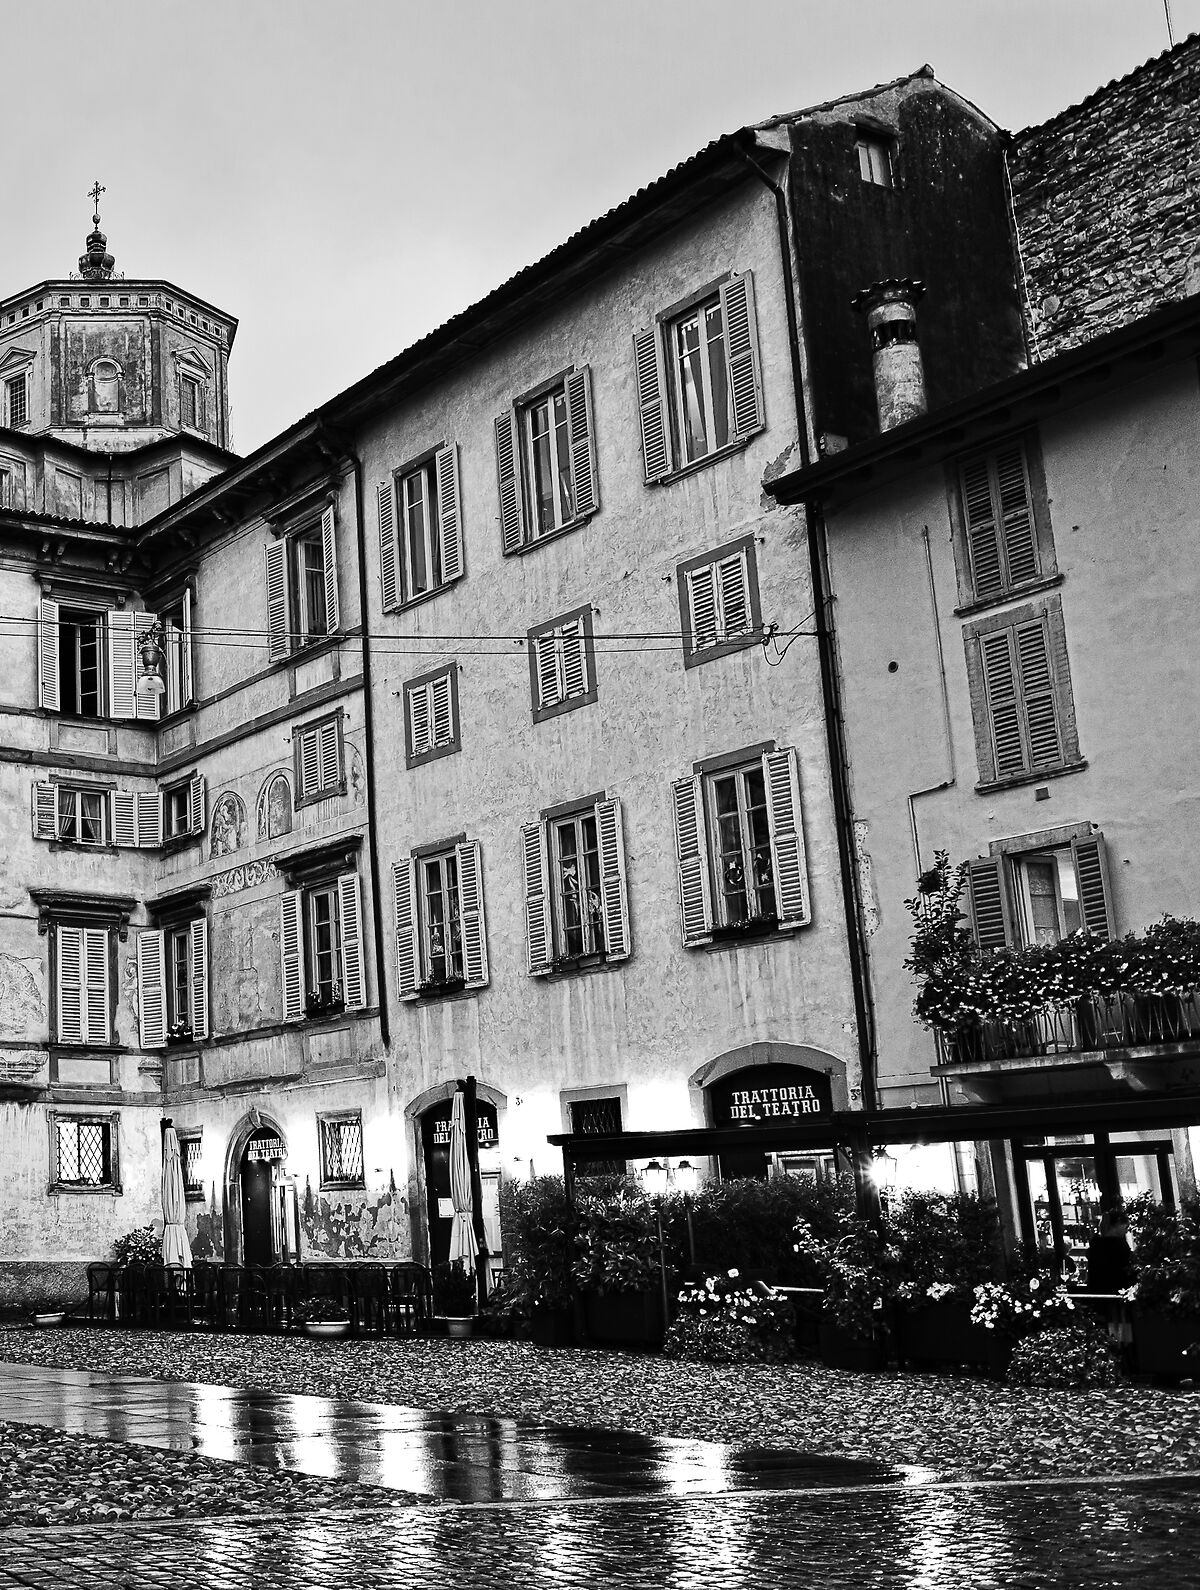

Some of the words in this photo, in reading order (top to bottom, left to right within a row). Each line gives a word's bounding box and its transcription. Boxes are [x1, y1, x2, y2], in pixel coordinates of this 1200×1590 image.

[732, 1085, 815, 1105] TRATTORIA
[730, 1105, 757, 1119] DEL
[762, 1099, 821, 1117] TEATRO
[433, 1132, 451, 1144] DEL
